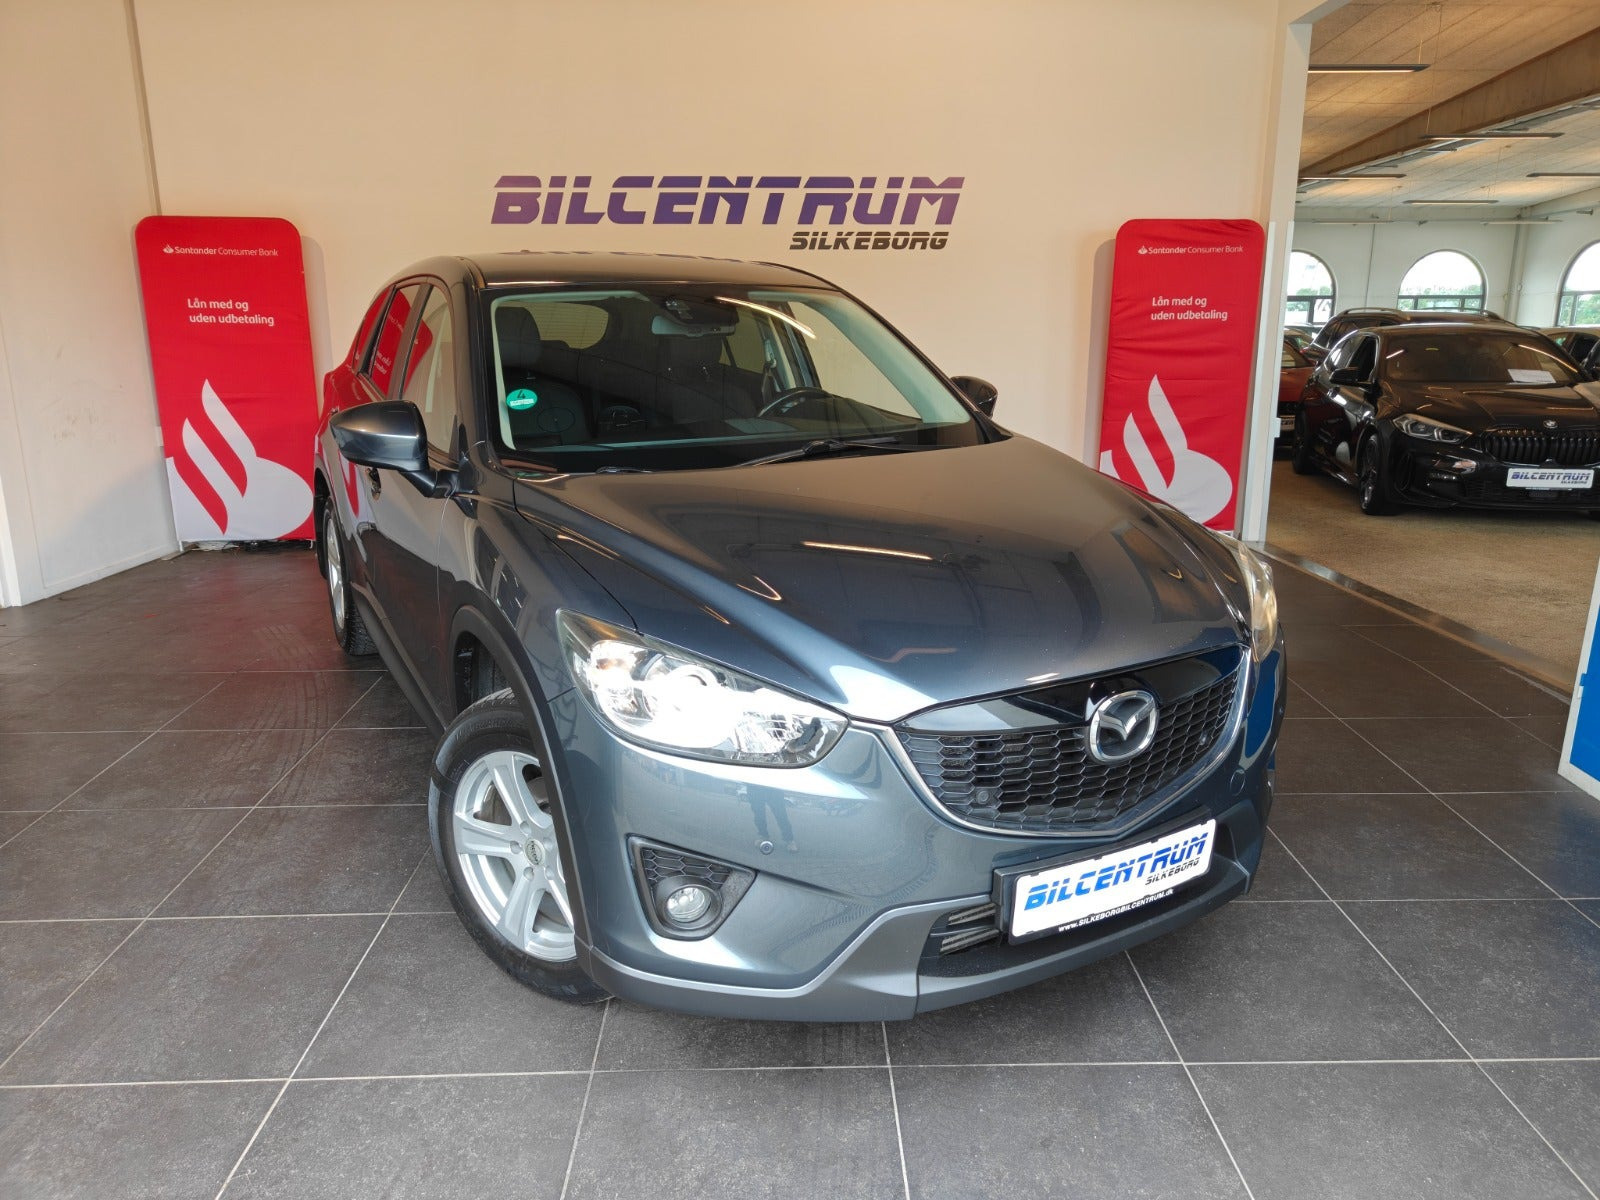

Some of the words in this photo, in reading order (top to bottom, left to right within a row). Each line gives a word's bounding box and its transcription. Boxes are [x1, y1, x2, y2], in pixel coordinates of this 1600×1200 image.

[491, 175, 965, 225] BILCENTRUM
[789, 231, 949, 250] SILKEBORG
[174, 246, 217, 255] Santander
[217, 247, 258, 256] Consumer
[258, 248, 279, 256] Bank
[1148, 246, 1187, 254] Santander
[1187, 246, 1224, 254] Consumer
[1225, 245, 1243, 253] Bank
[187, 298, 207, 308] Lån
[209, 299, 233, 309] med
[234, 301, 249, 311] og
[1152, 296, 1169, 306] Lån
[1171, 296, 1193, 306] med
[1195, 298, 1207, 307] og
[189, 313, 216, 323] uden
[218, 314, 274, 326] udbetaling
[1151, 311, 1175, 320] uden
[1177, 309, 1228, 321] udbetaling
[1511, 472, 1591, 480] BILCENTRUM
[1024, 832, 1208, 911] BILCENTRUM
[1145, 857, 1200, 886] SILKEBORG
[1058, 888, 1174, 932] www.SILKEBORGBILCENTRUM.dk
